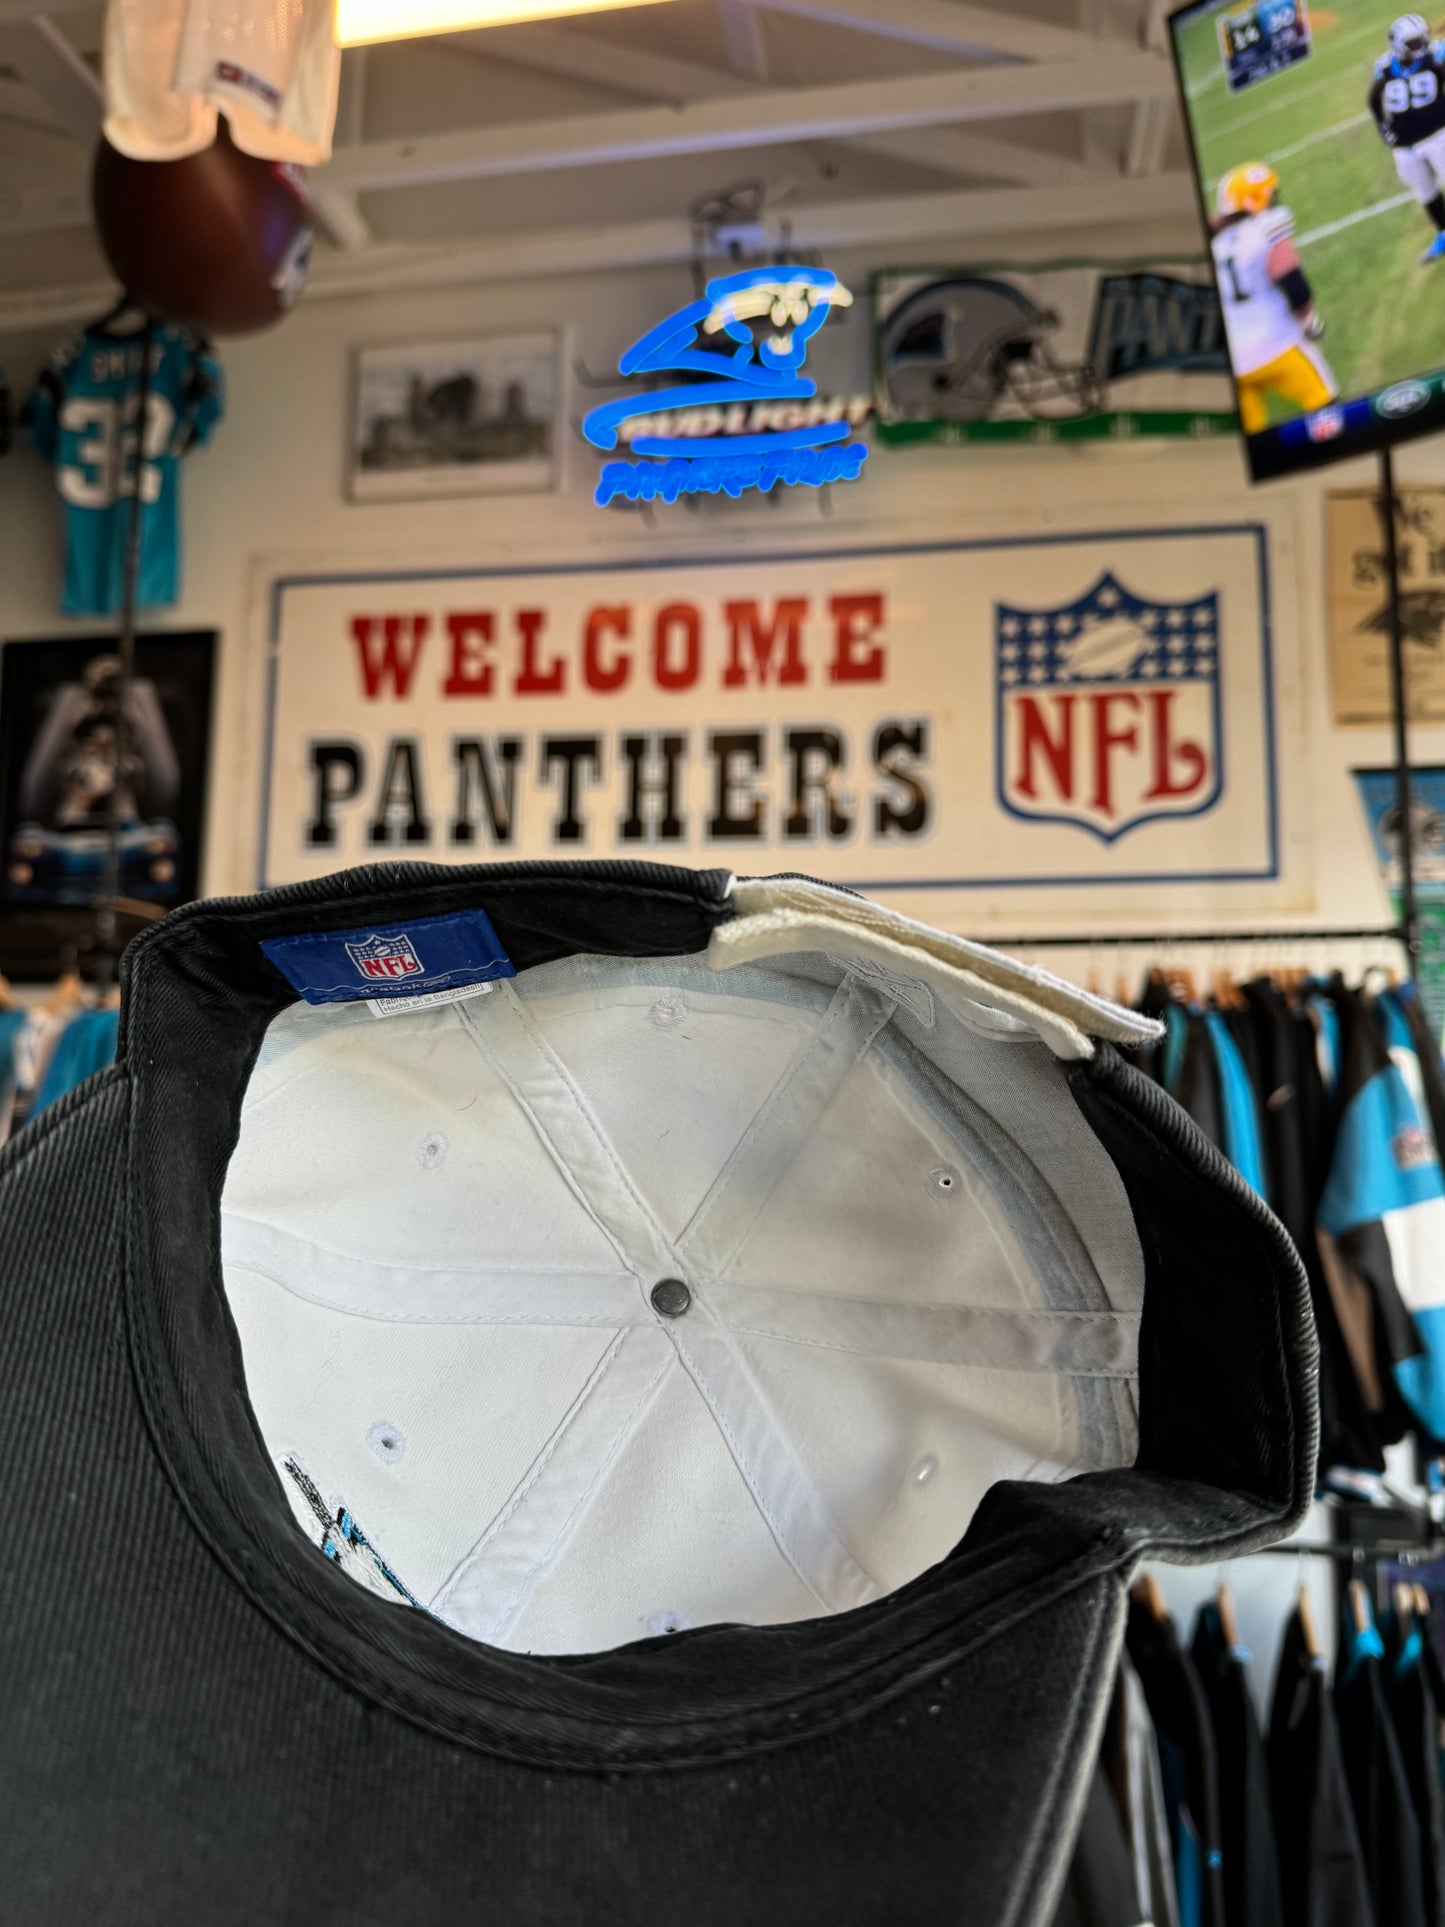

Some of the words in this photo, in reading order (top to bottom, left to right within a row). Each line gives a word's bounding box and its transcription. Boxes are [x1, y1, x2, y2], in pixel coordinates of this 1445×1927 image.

[1095, 276, 1222, 378] PANT
[348, 592, 888, 703] WELCOME
[305, 717, 932, 849] PANTHERS
[1013, 688, 1209, 820] NFL
[360, 954, 418, 978] NFL
[383, 1000, 411, 1013] Hecho
[434, 983, 481, 1001] Bangladesh
